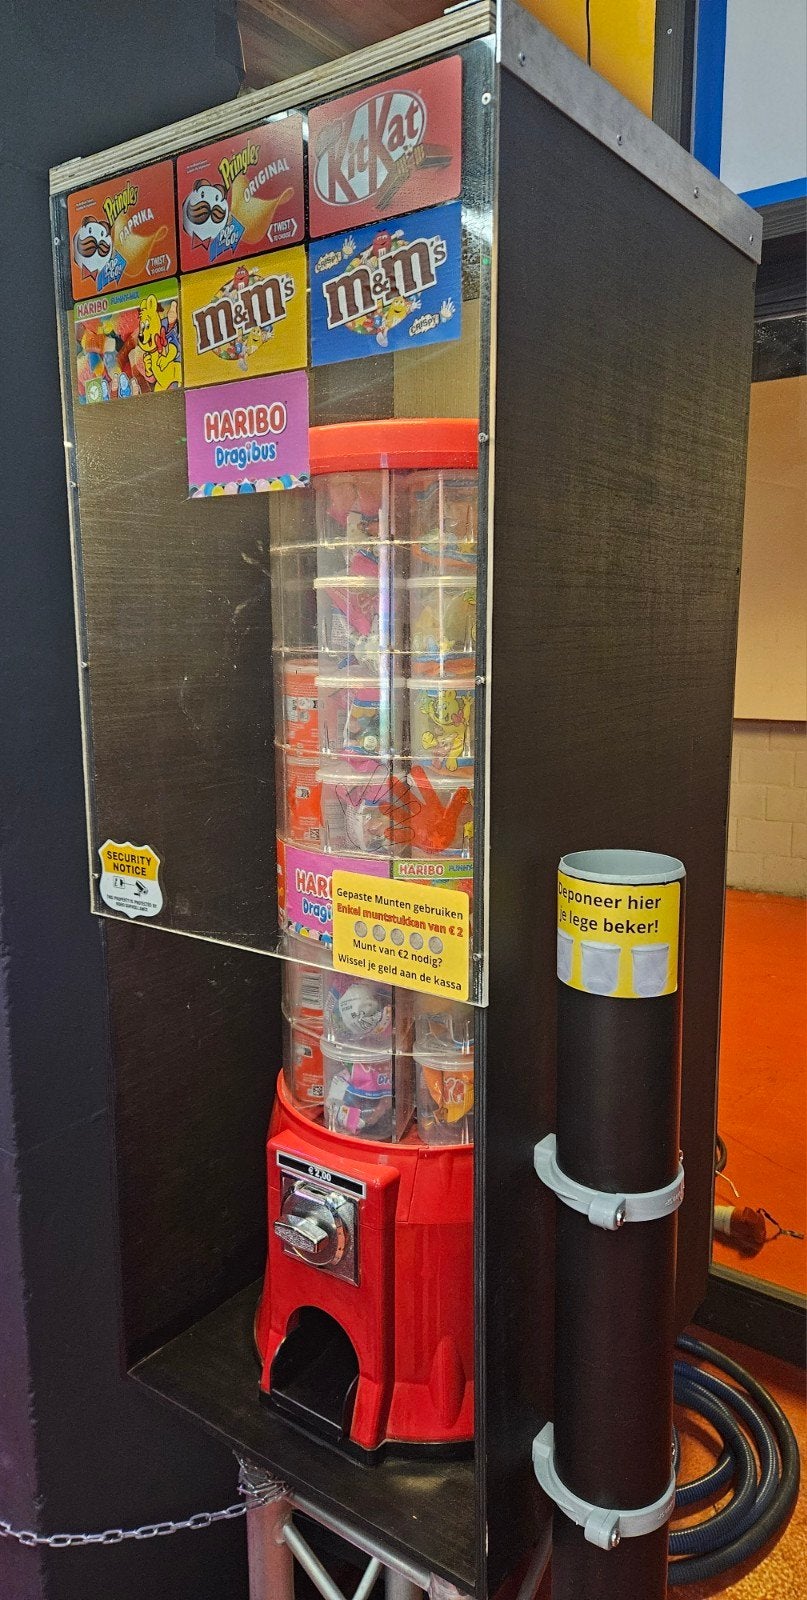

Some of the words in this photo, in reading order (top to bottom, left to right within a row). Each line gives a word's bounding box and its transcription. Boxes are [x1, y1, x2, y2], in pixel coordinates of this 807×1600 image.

[326, 93, 421, 203] KitKat
[218, 139, 260, 190] Pringles
[243, 158, 289, 202] ORIGINAL
[103, 180, 138, 226] Pringles
[119, 208, 154, 241] PAPRIKA
[219, 225, 235, 241] POP
[273, 220, 290, 232] TWIST
[105, 258, 118, 273] POP
[151, 255, 165, 266] TWIST
[316, 253, 340, 271] CRISPY
[77, 299, 108, 317] HARIBO
[411, 318, 437, 334] CRISPY
[204, 402, 286, 442] HARIBO
[215, 440, 276, 470] Dragibus
[107, 851, 151, 866] SECURITY
[113, 863, 146, 876] NOTICE
[399, 864, 444, 877] HARIBO
[295, 868, 333, 900] HARI
[559, 882, 622, 908] Deponeer
[627, 896, 661, 909] hier
[302, 897, 333, 923] Dragi
[337, 888, 372, 902] Gepaste
[375, 895, 411, 909] Munten
[413, 904, 463, 920] gebruiken
[337, 903, 361, 916] Enkel
[363, 909, 426, 930] muntstukken
[428, 923, 446, 934] van
[560, 906, 567, 922] je
[569, 911, 598, 931] lege
[603, 918, 659, 933] beker!
[353, 939, 377, 952] Munt
[379, 946, 396, 956] van
[398, 949, 409, 959] €2
[411, 954, 442, 968] nodig?
[338, 953, 366, 967] Wissel
[367, 960, 376, 971] je
[378, 965, 398, 974] geld
[400, 969, 417, 980] aan
[420, 973, 431, 983] de
[434, 976, 461, 990] kassa
